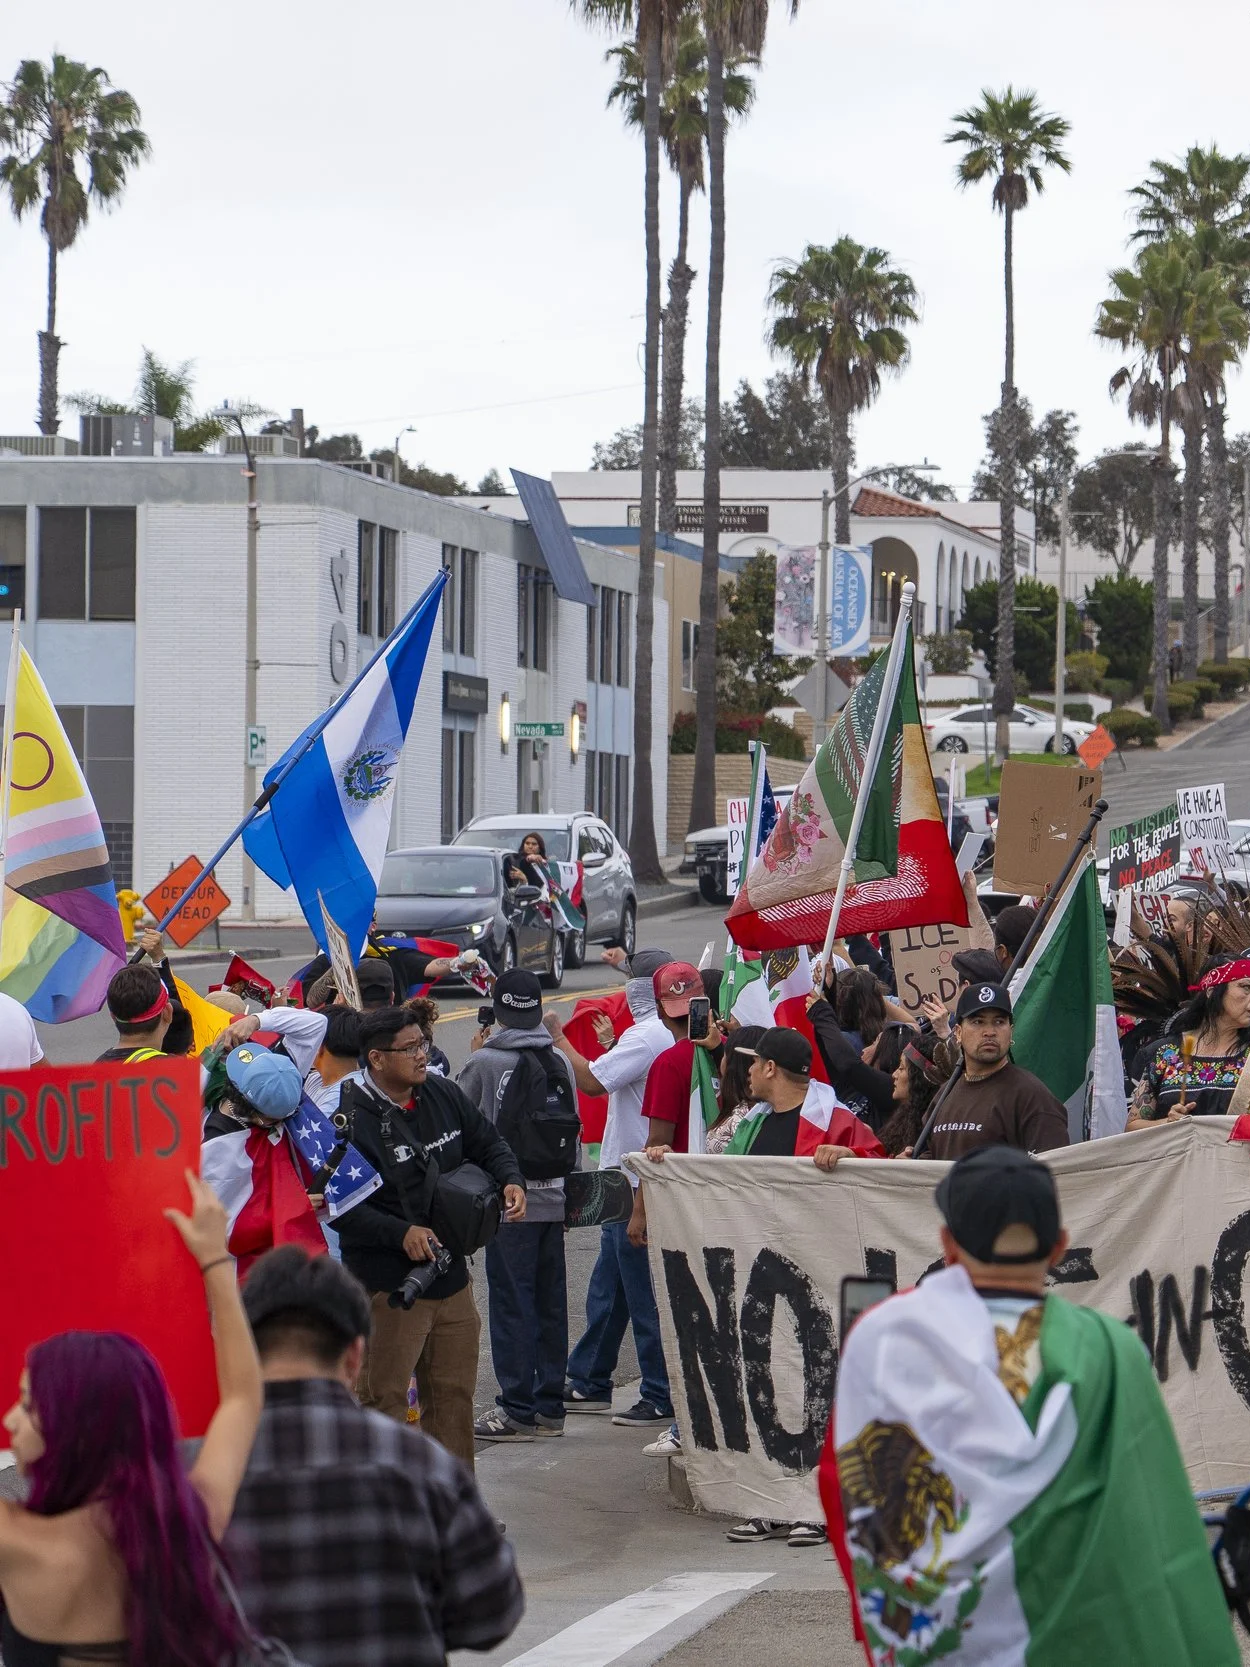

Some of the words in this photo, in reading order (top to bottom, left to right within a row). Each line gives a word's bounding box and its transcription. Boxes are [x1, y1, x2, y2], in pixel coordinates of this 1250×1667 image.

[834, 604, 844, 619] OF
[847, 565, 859, 631] OCEANSIDE
[833, 623, 843, 645] ART
[515, 723, 546, 736] Nevada
[1178, 791, 1192, 816] WE
[1192, 789, 1213, 815] HAVE
[1214, 788, 1223, 813] A
[1110, 826, 1128, 848] NO
[1131, 802, 1179, 839] JUSTICE
[1110, 842, 1130, 864] FOR
[1132, 833, 1150, 854] THE
[1153, 819, 1181, 846] PEOPLE
[1136, 843, 1162, 865] MEANS
[1119, 868, 1136, 887] NO
[1141, 848, 1173, 879] PEACE
[900, 924, 959, 952] ICE
[930, 966, 942, 975] of
[661, 1246, 839, 1474] NO
[1128, 1264, 1208, 1383] IN
